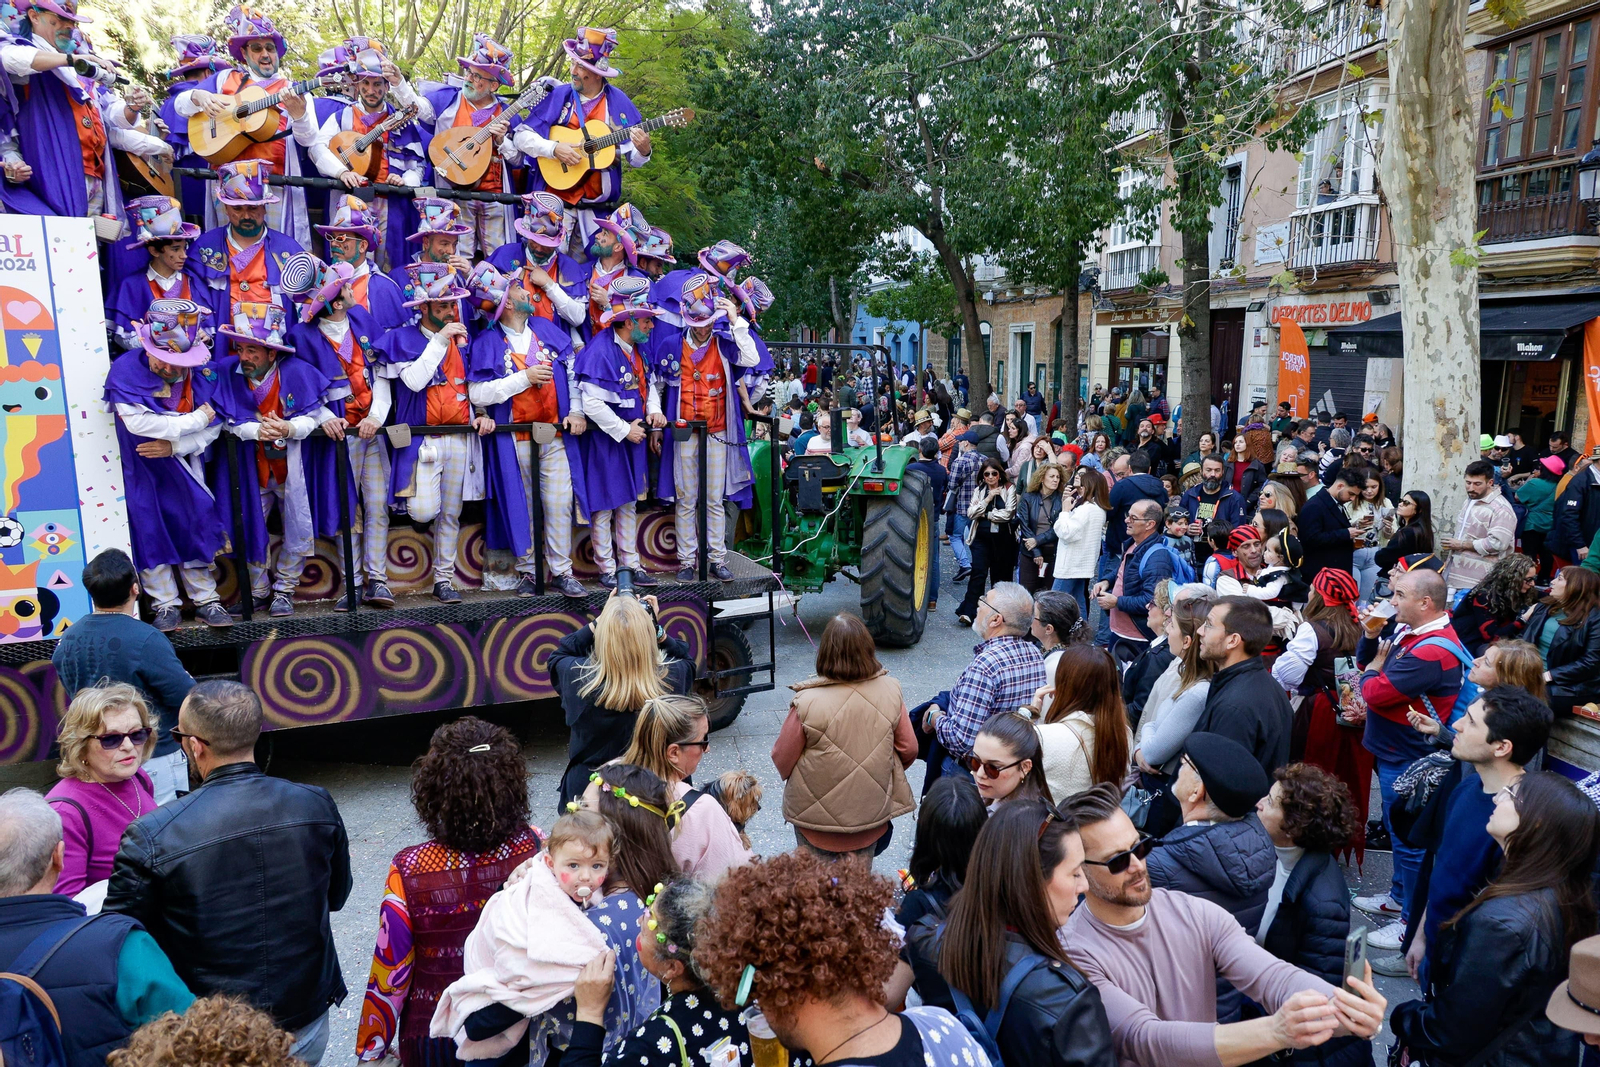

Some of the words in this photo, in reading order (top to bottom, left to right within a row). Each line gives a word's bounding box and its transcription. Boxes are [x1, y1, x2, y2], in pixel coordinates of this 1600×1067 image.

[1271, 303, 1327, 324] DEPORTES
[1329, 301, 1372, 322] DELMO
[1517, 343, 1543, 352] Mahou
